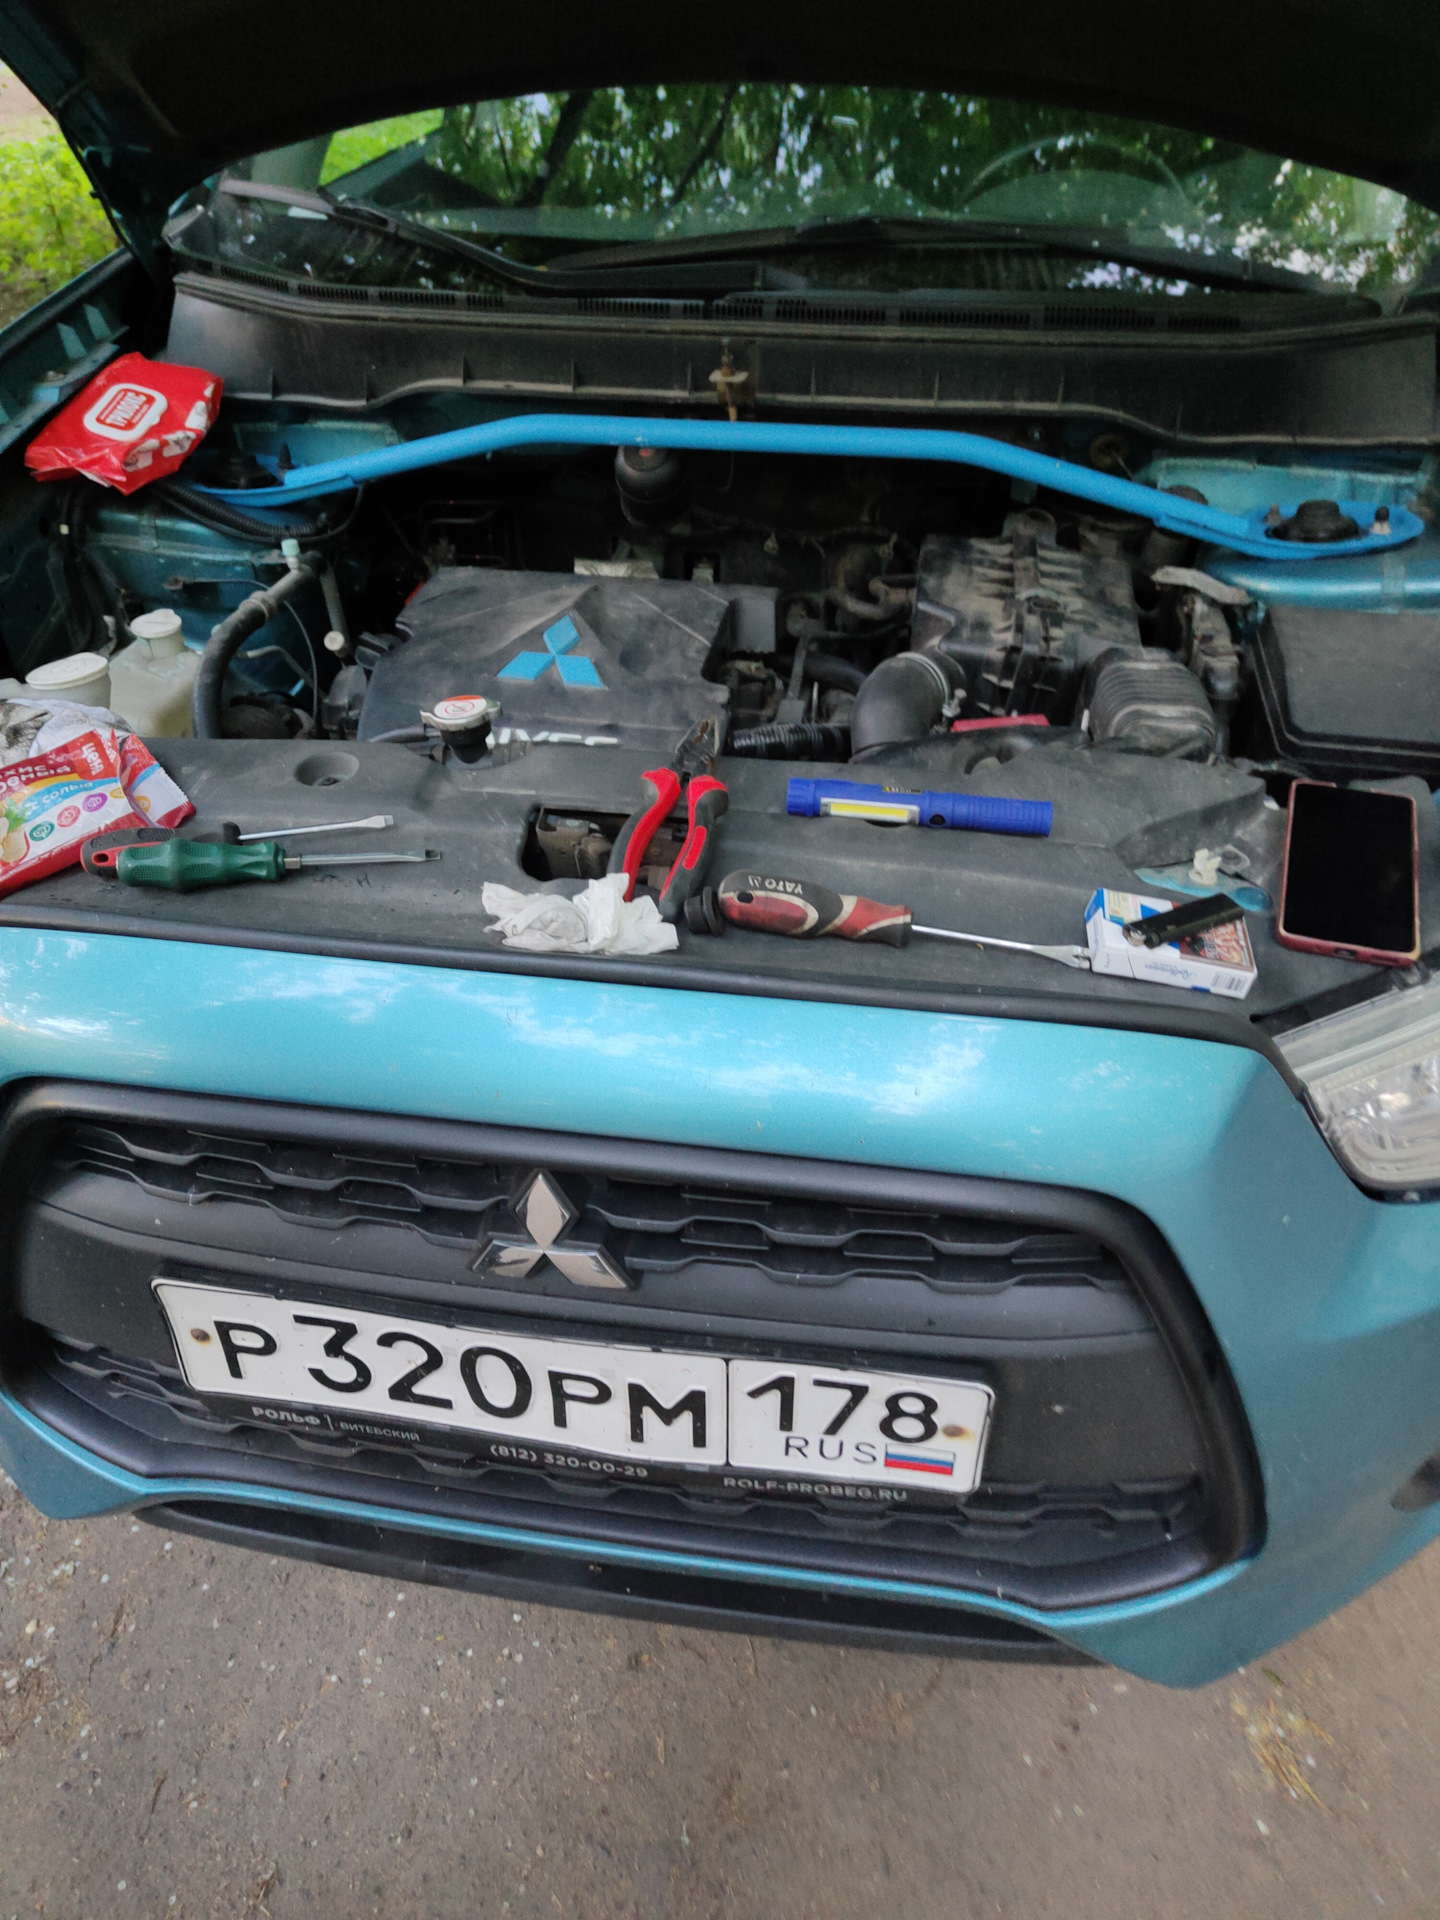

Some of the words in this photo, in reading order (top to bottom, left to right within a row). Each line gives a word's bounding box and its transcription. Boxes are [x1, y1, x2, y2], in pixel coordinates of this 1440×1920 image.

[764, 878, 803, 895] YATO
[252, 1406, 321, 1426] РОЛЬФ
[339, 1420, 421, 1442] ВИТЕБСКИЙ
[745, 1376, 939, 1443] 178
[490, 1444, 538, 1463] (812)
[543, 1452, 648, 1478] 320-00-29
[784, 1436, 878, 1464] RUS
[723, 1476, 908, 1501] ROLF-PROBEG.RU
